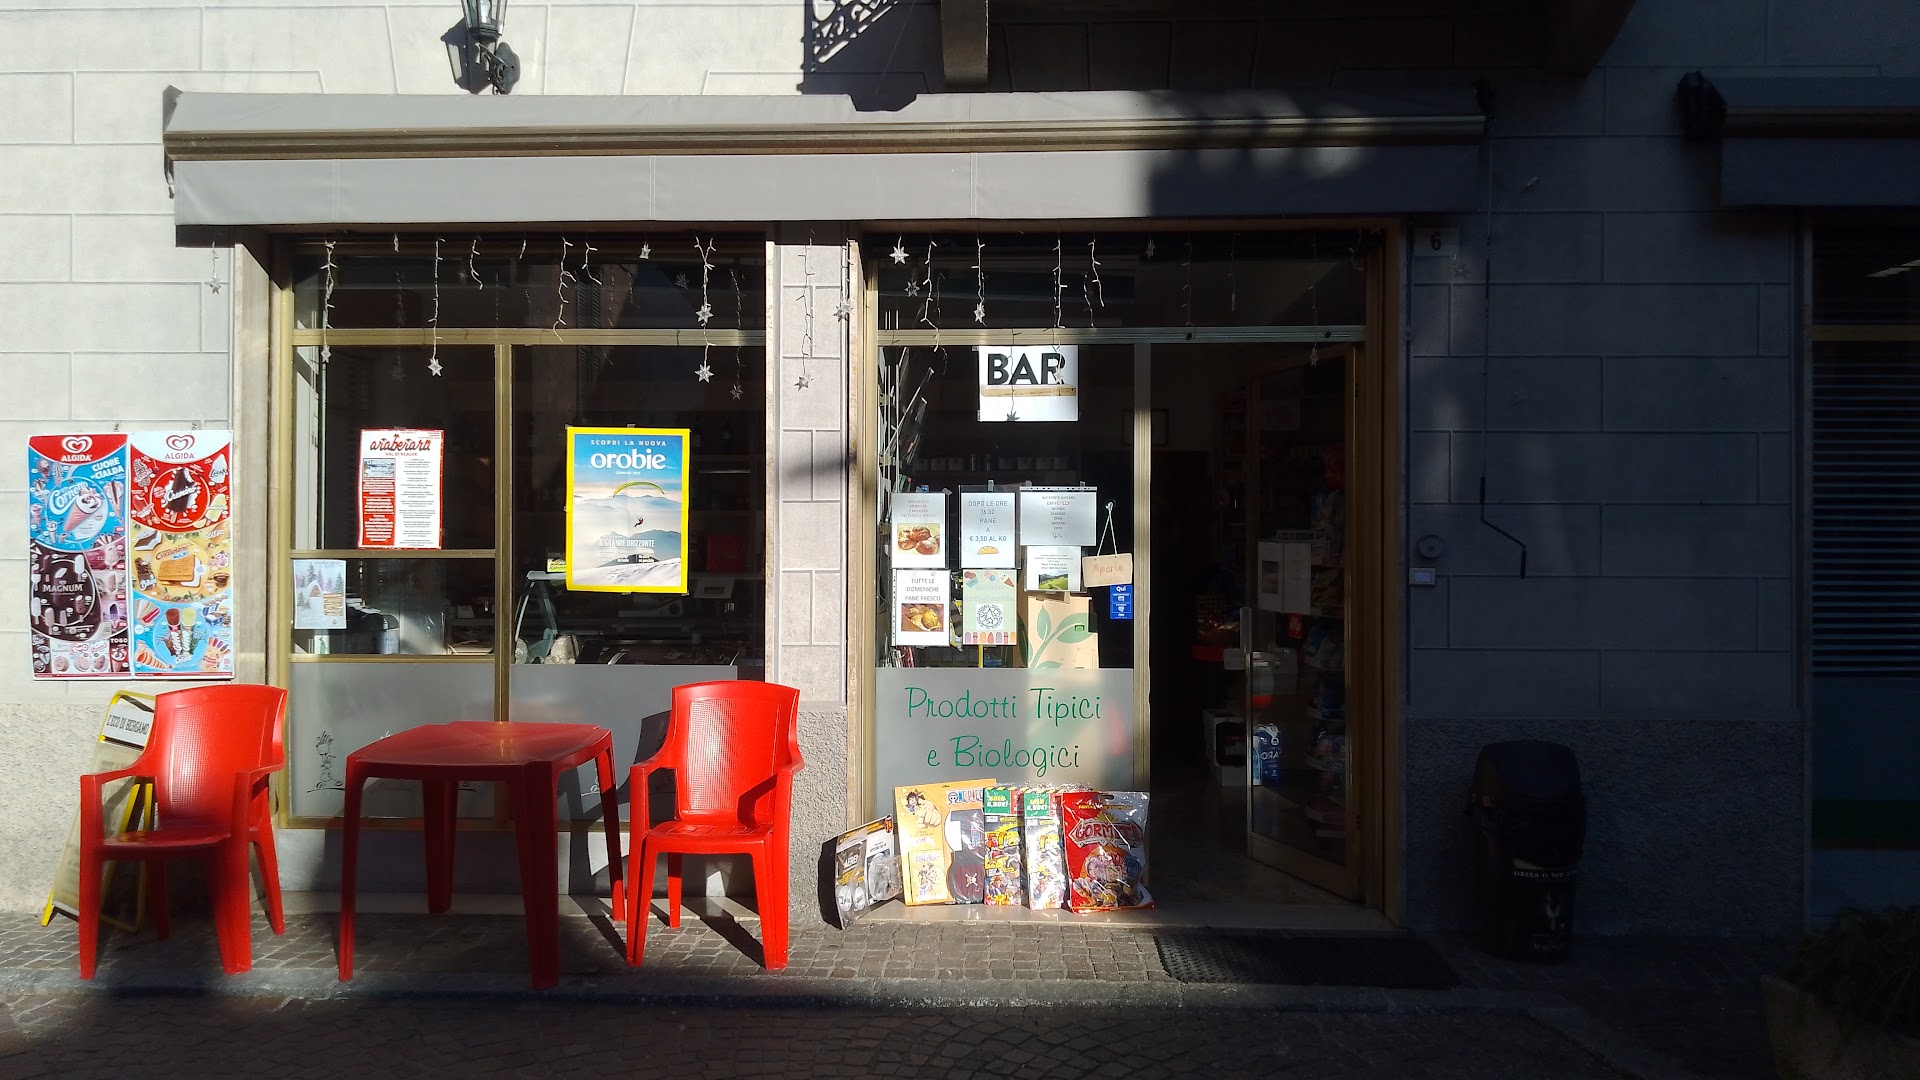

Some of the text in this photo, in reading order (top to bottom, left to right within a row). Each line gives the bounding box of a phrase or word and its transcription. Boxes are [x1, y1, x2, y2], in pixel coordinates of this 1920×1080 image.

[1430, 231, 1441, 251] 6
[987, 352, 1065, 385] BAR
[61, 454, 92, 462] ALGIDA
[91, 456, 120, 472] CUORE
[165, 452, 195, 460] ALGIDA
[590, 448, 667, 470] orobie
[95, 465, 125, 480] CIALDA
[626, 539, 656, 548] ORIZZONTE
[42, 583, 84, 593] MAGNUM
[904, 687, 1101, 727] Prodotti Tipici
[125, 719, 150, 735] BERGAMO
[927, 735, 1080, 778] e Biologici
[1075, 823, 1143, 842] GORMITI
[1513, 870, 1540, 878] LIBERA
